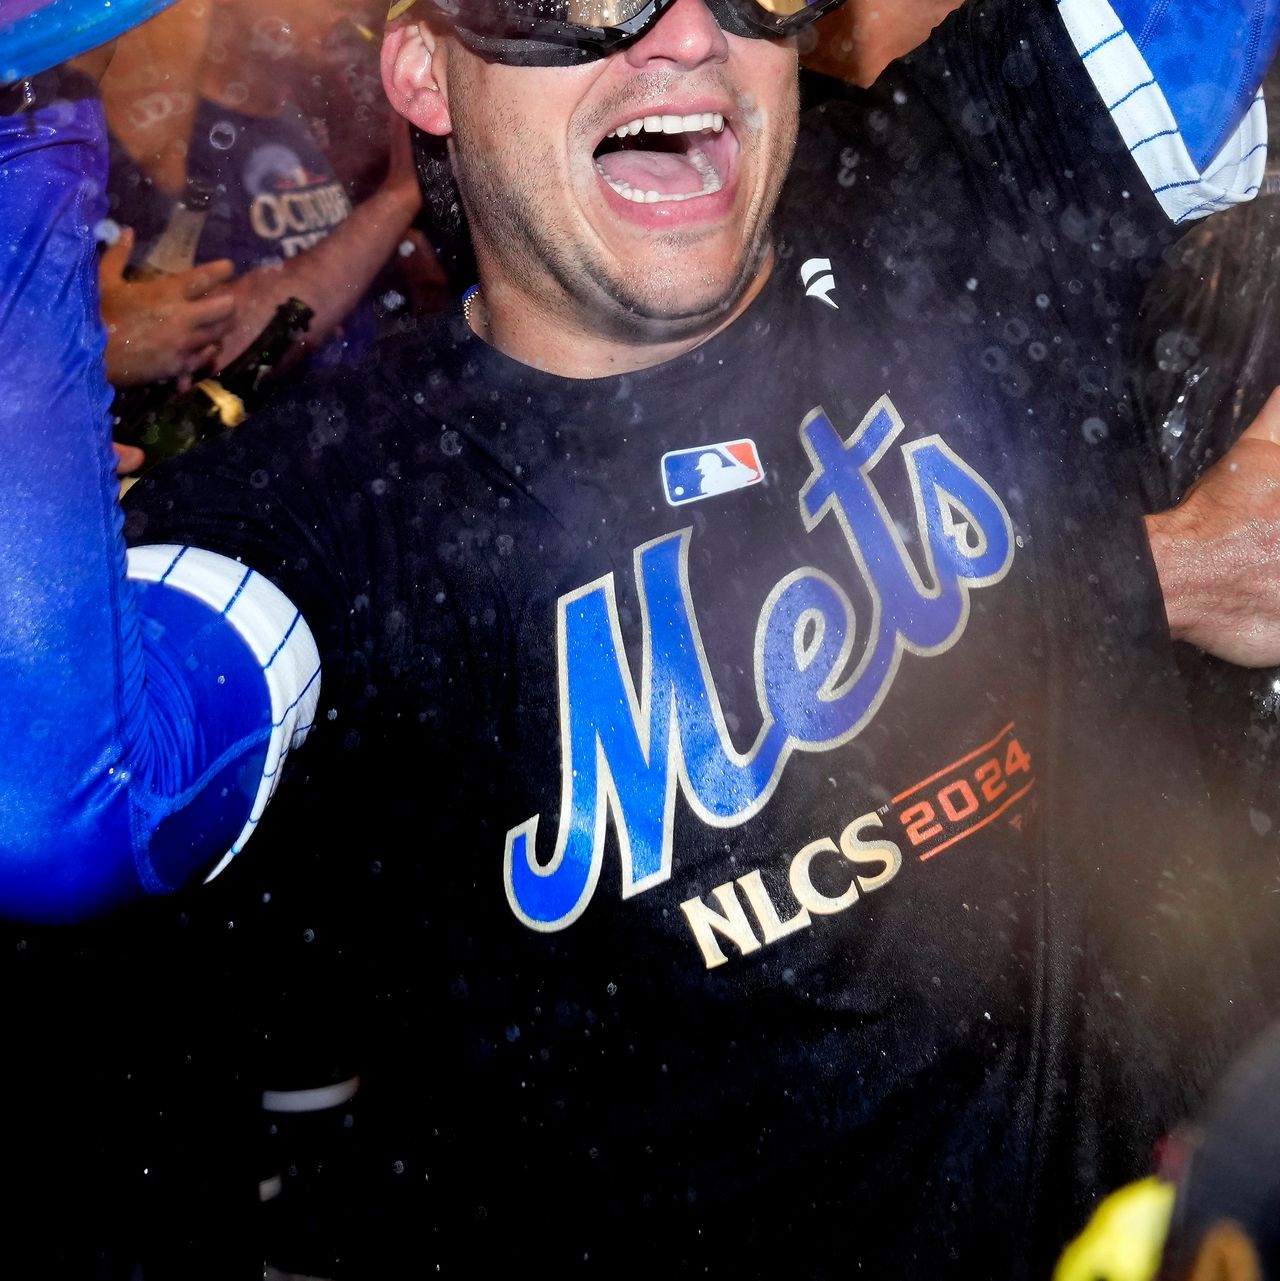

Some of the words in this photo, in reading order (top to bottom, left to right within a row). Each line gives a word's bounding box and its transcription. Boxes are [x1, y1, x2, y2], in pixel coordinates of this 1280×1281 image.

[503, 393, 1015, 932] Mets
[679, 811, 903, 969] NLCS
[900, 737, 1032, 847] 2024
